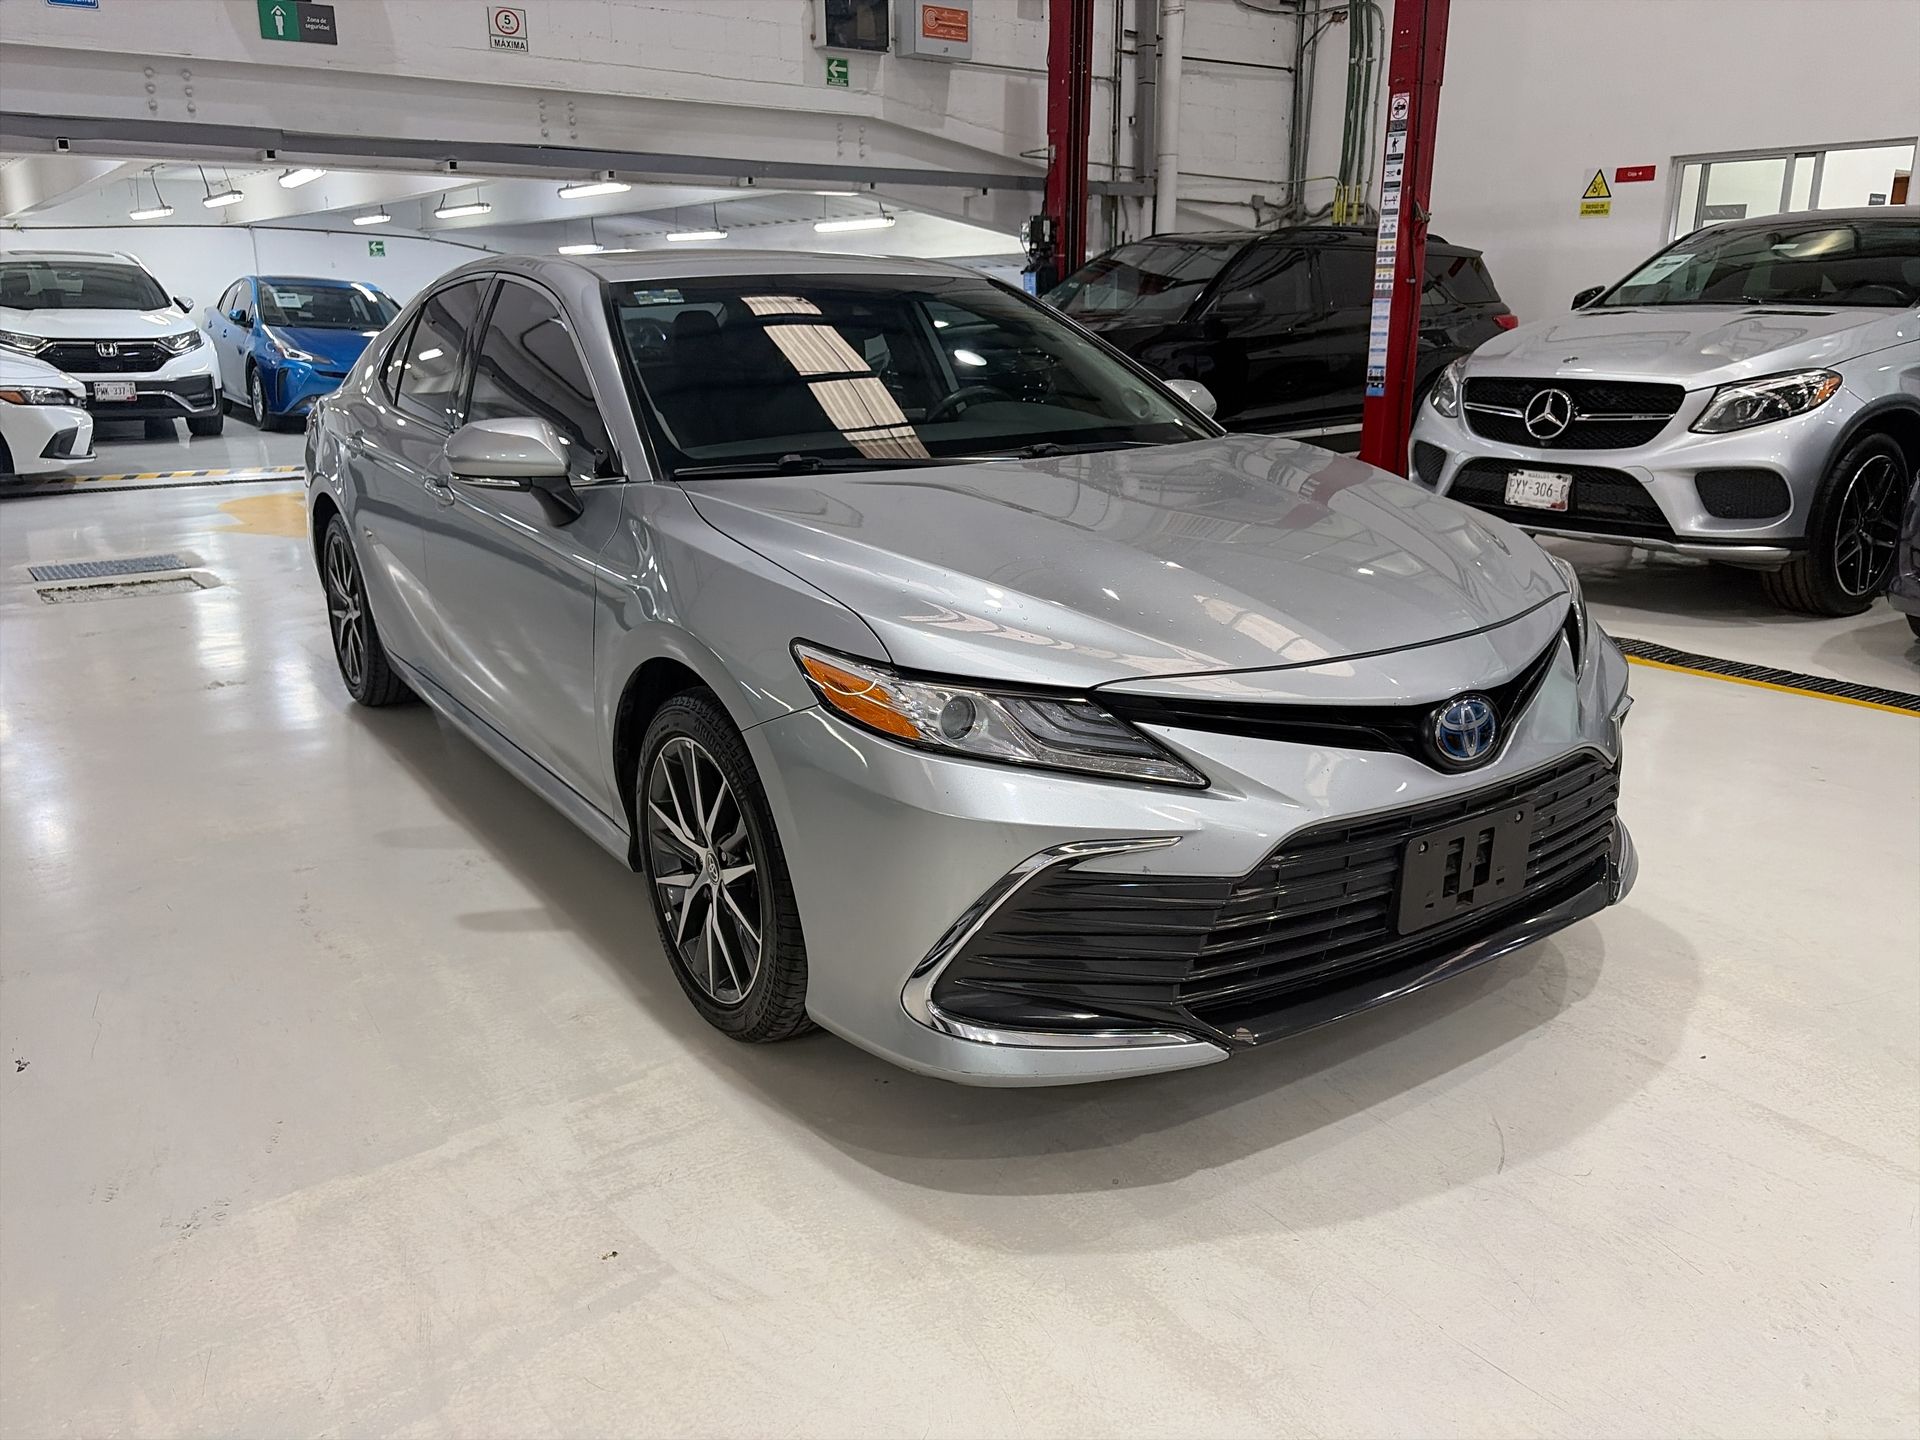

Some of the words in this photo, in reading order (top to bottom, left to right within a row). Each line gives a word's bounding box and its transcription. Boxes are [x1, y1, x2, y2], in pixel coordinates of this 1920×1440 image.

[504, 14, 511, 25] 5
[305, 23, 330, 31] seguridad
[494, 37, 526, 50] MÁXIMA
